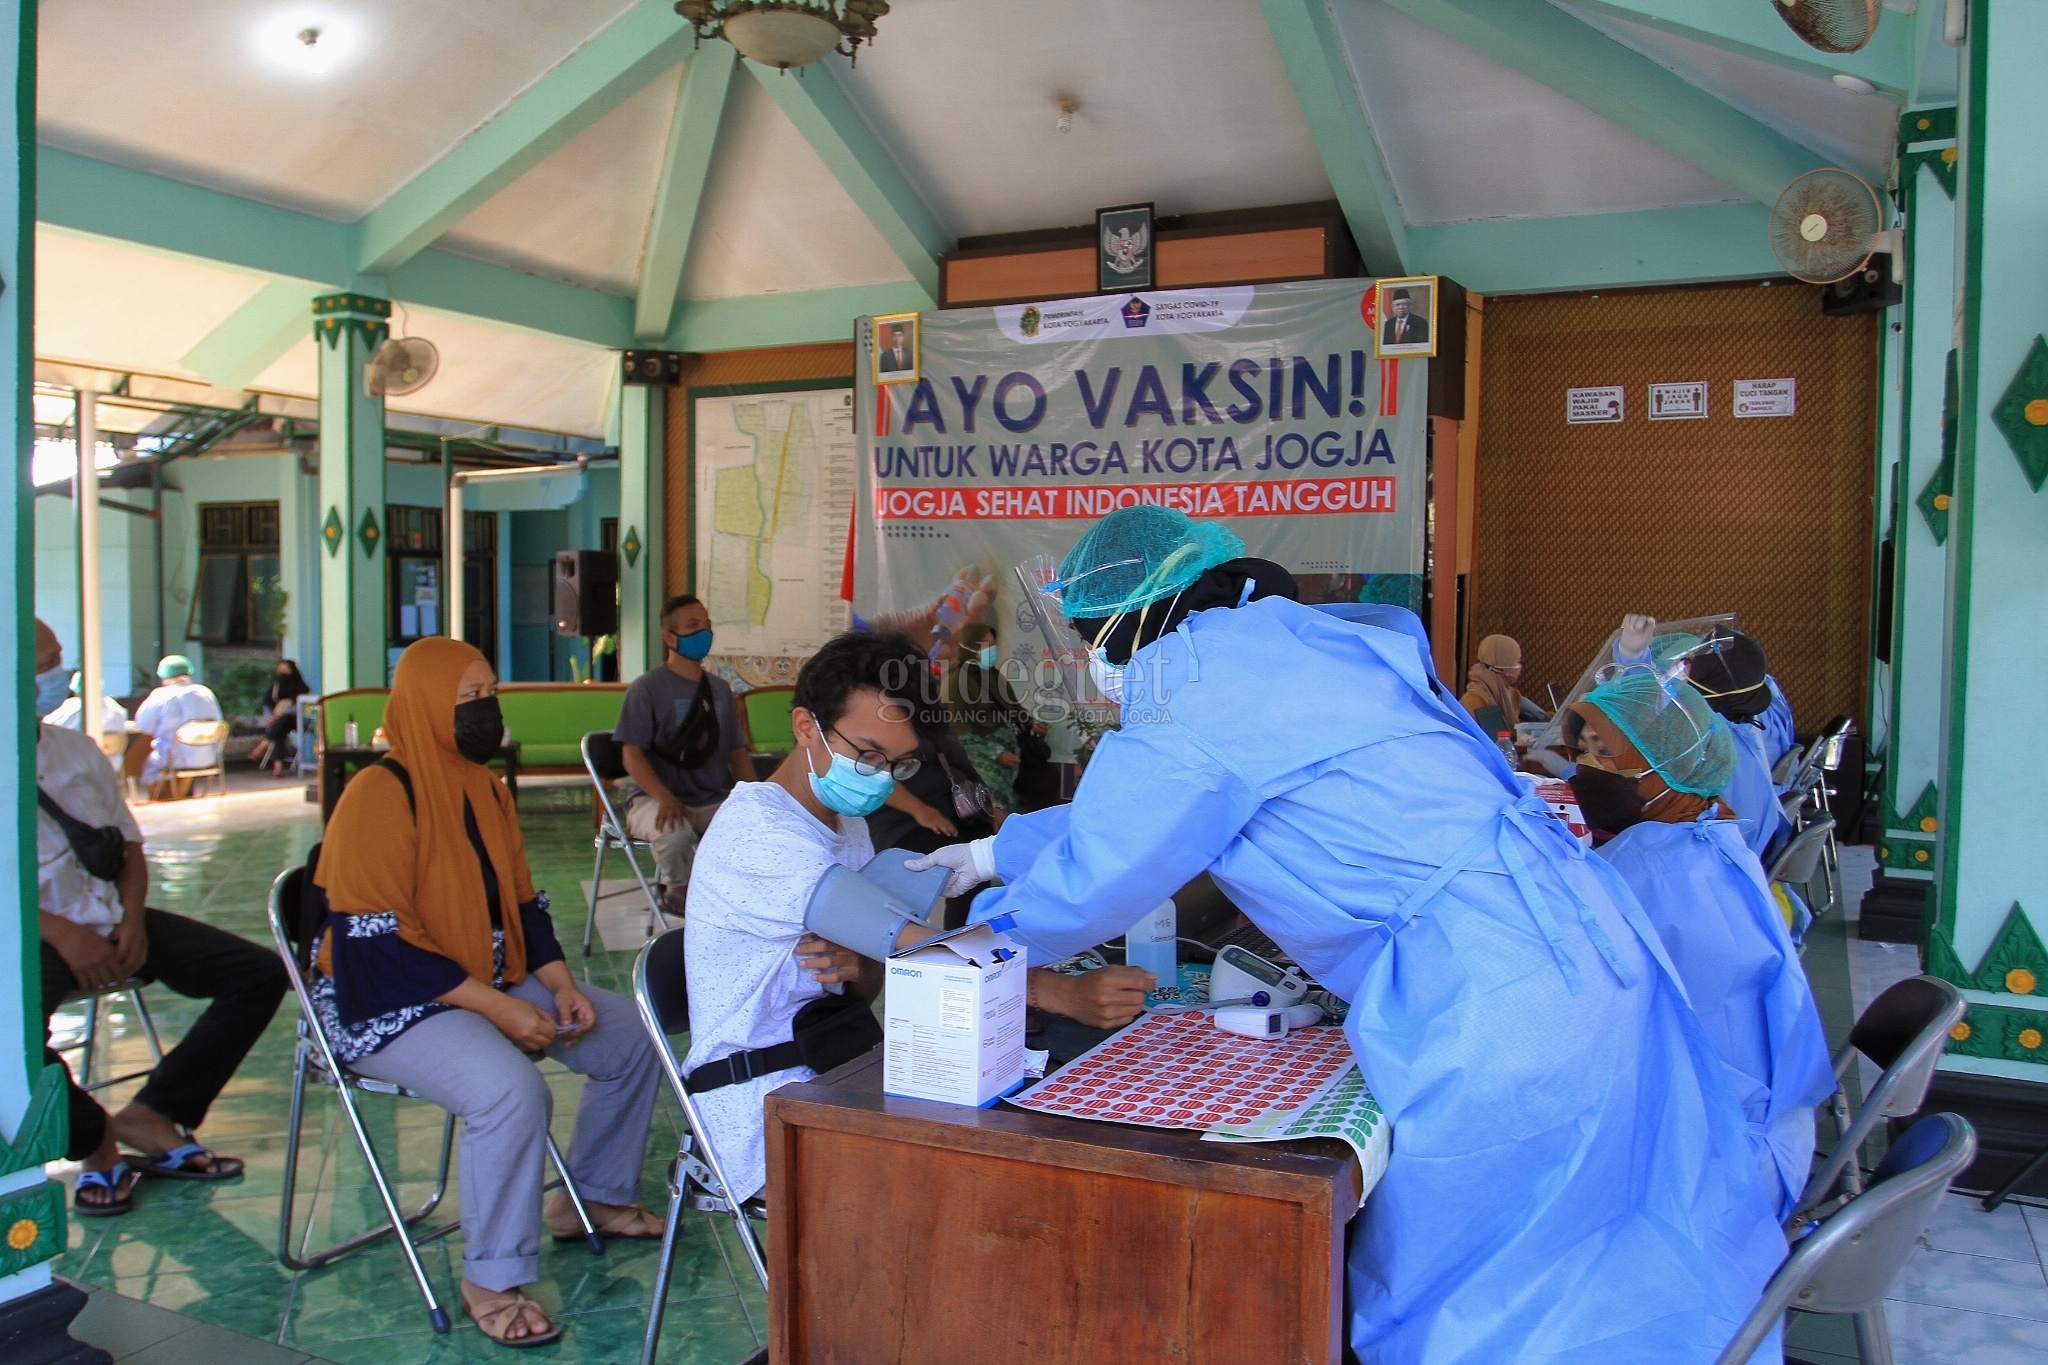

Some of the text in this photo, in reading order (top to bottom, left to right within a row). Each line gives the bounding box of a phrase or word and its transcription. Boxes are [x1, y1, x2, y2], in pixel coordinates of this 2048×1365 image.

[1155, 299, 1220, 311] SATGAS COVID-19
[1043, 310, 1084, 320] PEMERINTAH
[1155, 309, 1224, 321] KOTA YOGYAKARTA
[1043, 318, 1110, 329] KOTA YOGYAKARTA
[903, 350, 1366, 434] AYO VAKSIN!
[1572, 391, 1616, 399] KAWASAN
[874, 428, 1396, 480] UNTUK WARGA KOTA JOGJA
[877, 479, 1392, 516] JOGJA SEHAT INDONESIA TANGGUH
[890, 967, 922, 978] OMRON
